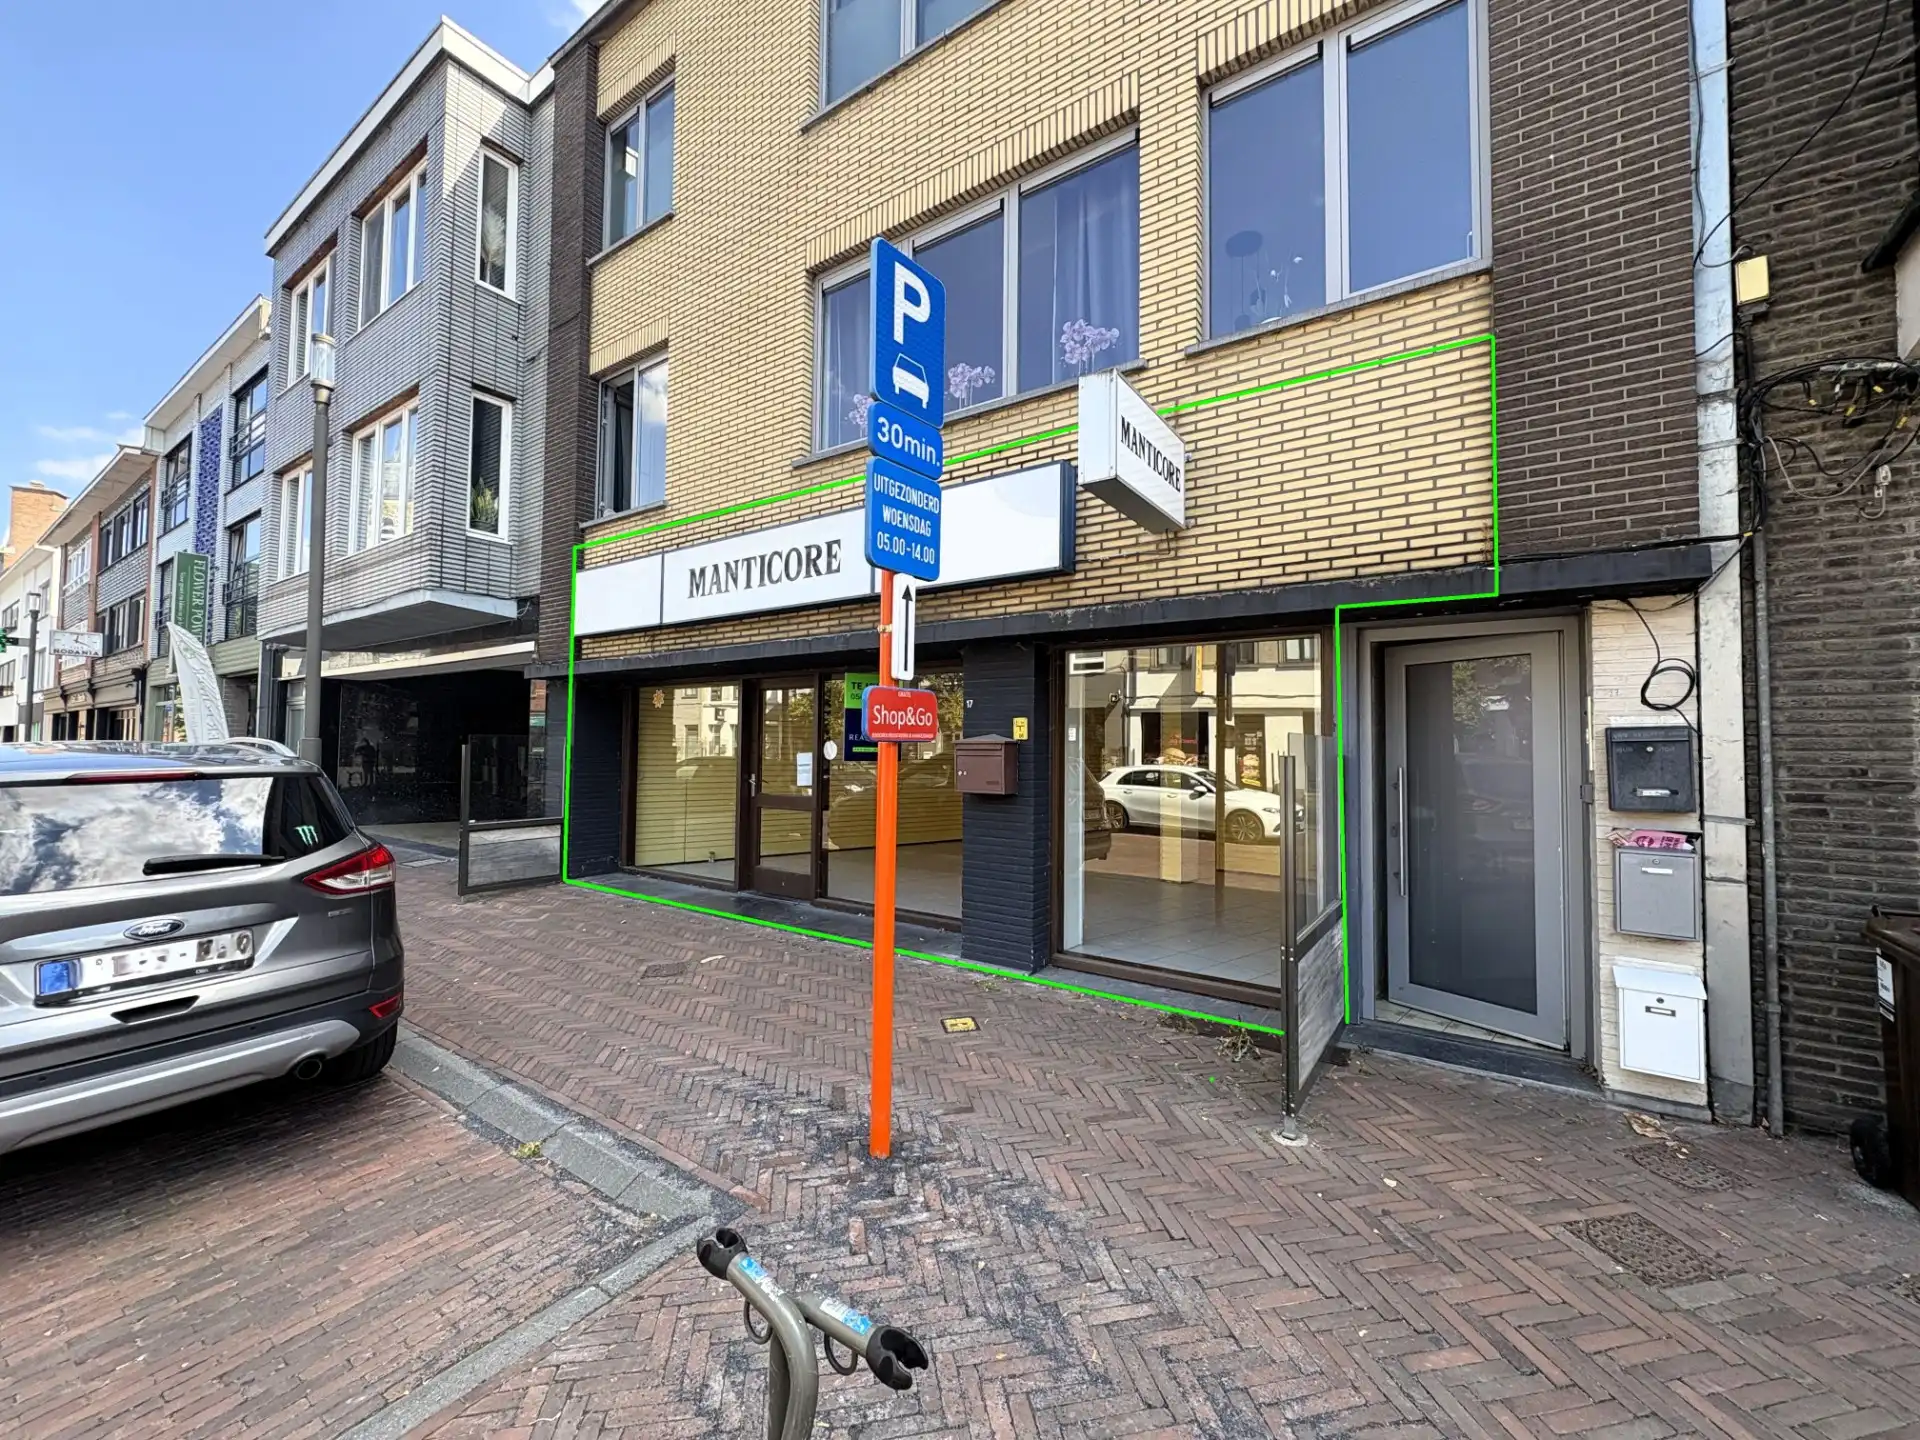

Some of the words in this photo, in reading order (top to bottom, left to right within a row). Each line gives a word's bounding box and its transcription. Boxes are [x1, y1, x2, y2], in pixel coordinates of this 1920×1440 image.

[894, 261, 931, 345] P
[1120, 415, 1181, 493] MANTICORE
[874, 473, 940, 514] UITGEZONDERD
[882, 504, 932, 537] WOENSDAG
[877, 531, 935, 565] 05.00-14.00
[192, 560, 206, 606] FLOWER
[687, 539, 841, 599] MANTICORE
[851, 682, 862, 690] TE
[872, 704, 933, 730] Shop&Go
[966, 699, 974, 709] 17
[139, 923, 171, 935] Ford
